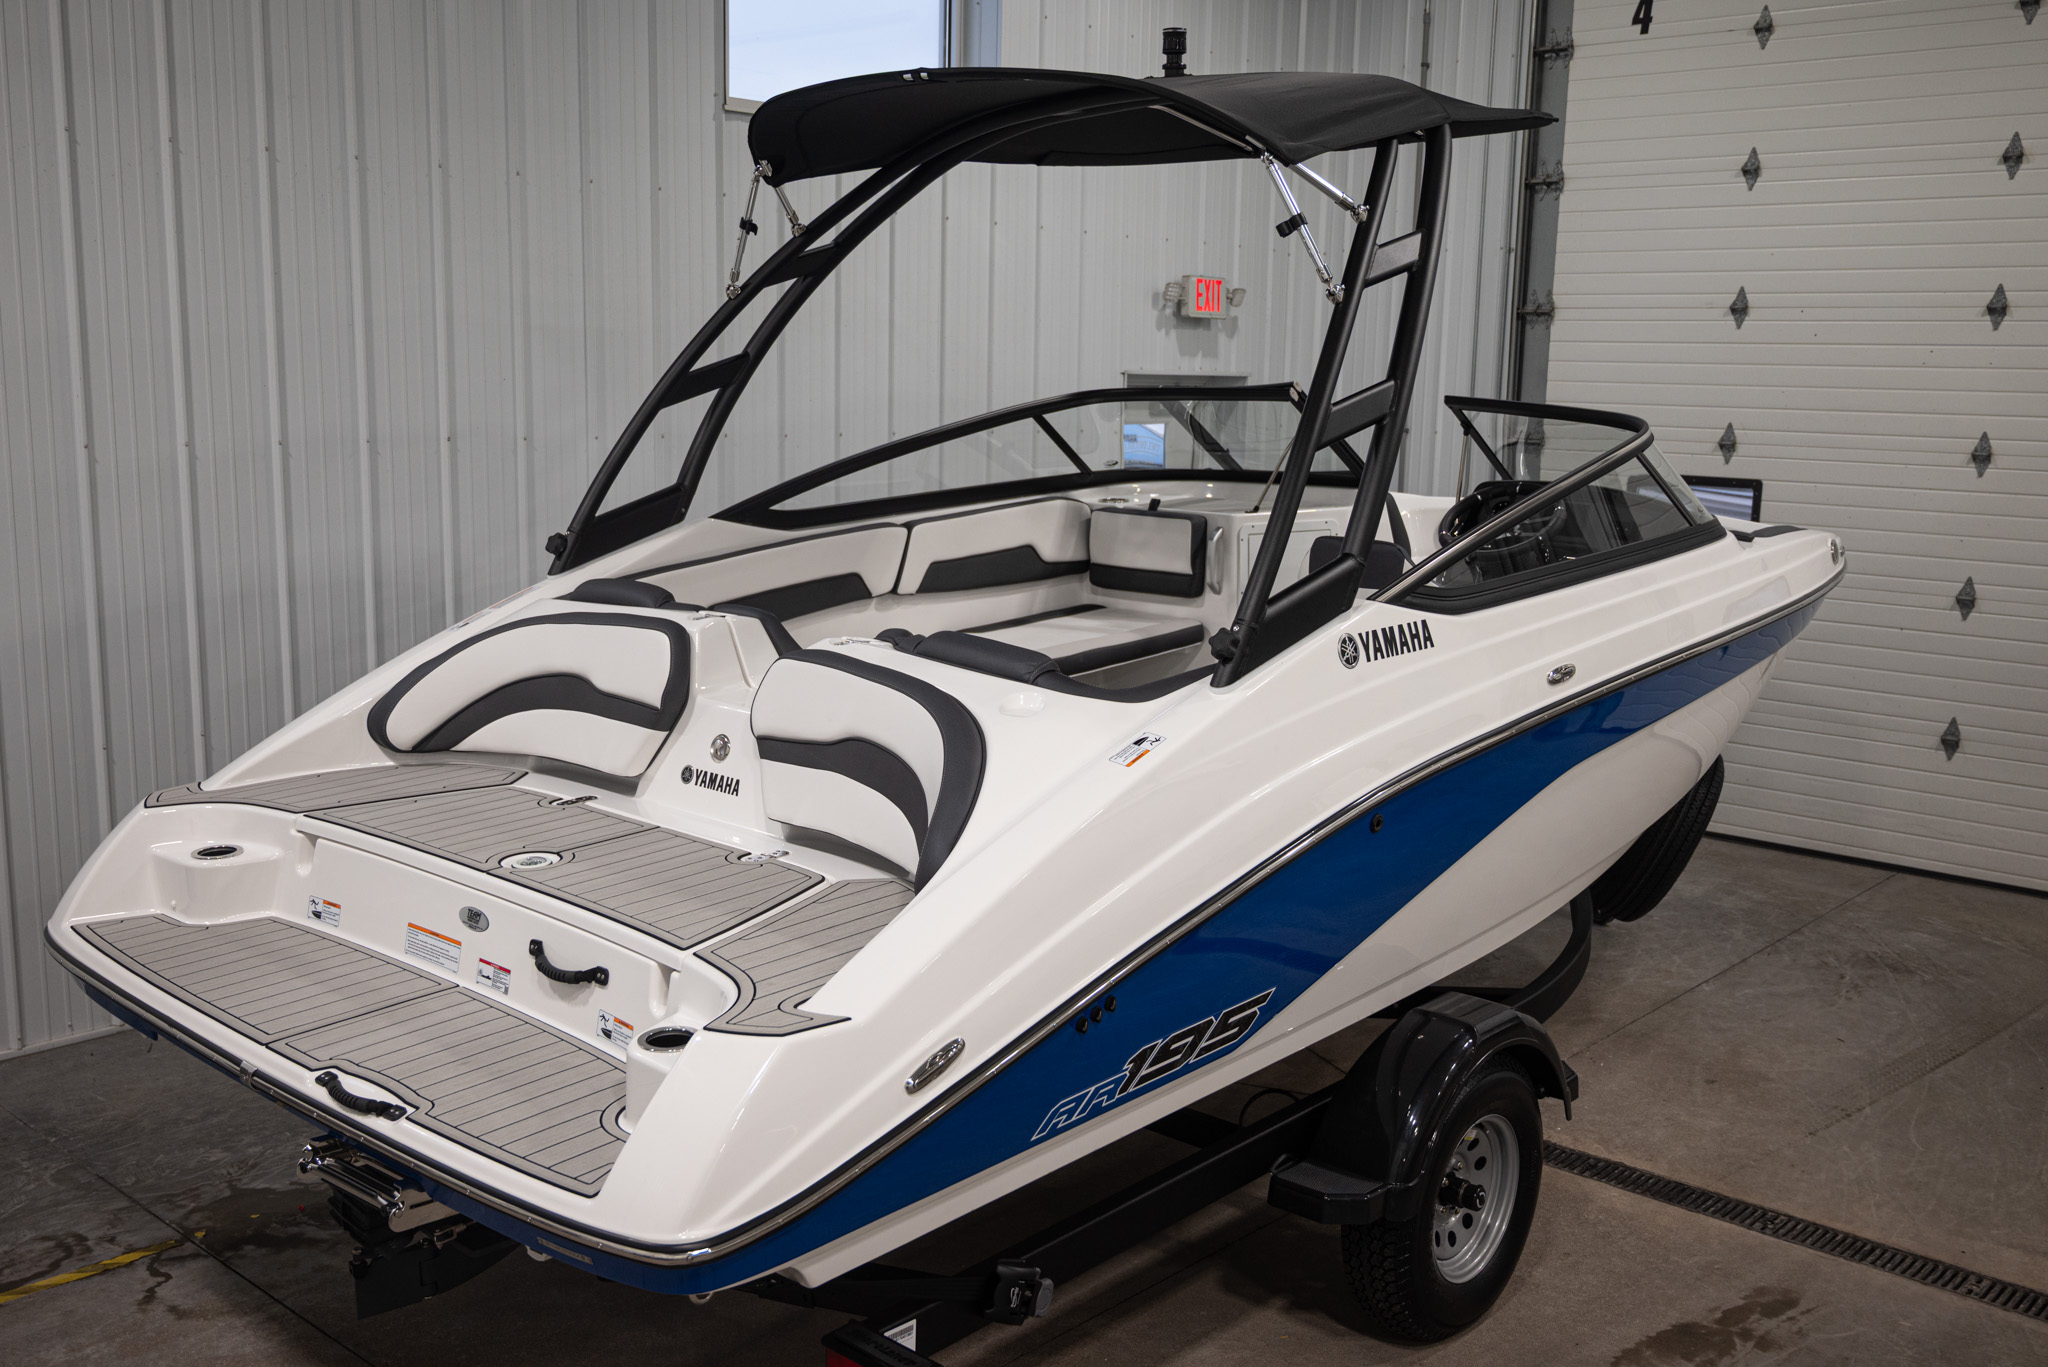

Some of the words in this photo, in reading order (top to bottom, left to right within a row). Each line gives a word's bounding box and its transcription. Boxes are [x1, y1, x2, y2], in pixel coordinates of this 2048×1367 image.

[1631, 0, 1653, 35] 4
[1196, 278, 1222, 313] EXIT
[1358, 619, 1435, 663] YAMAHA
[694, 768, 741, 797] YAMAHA
